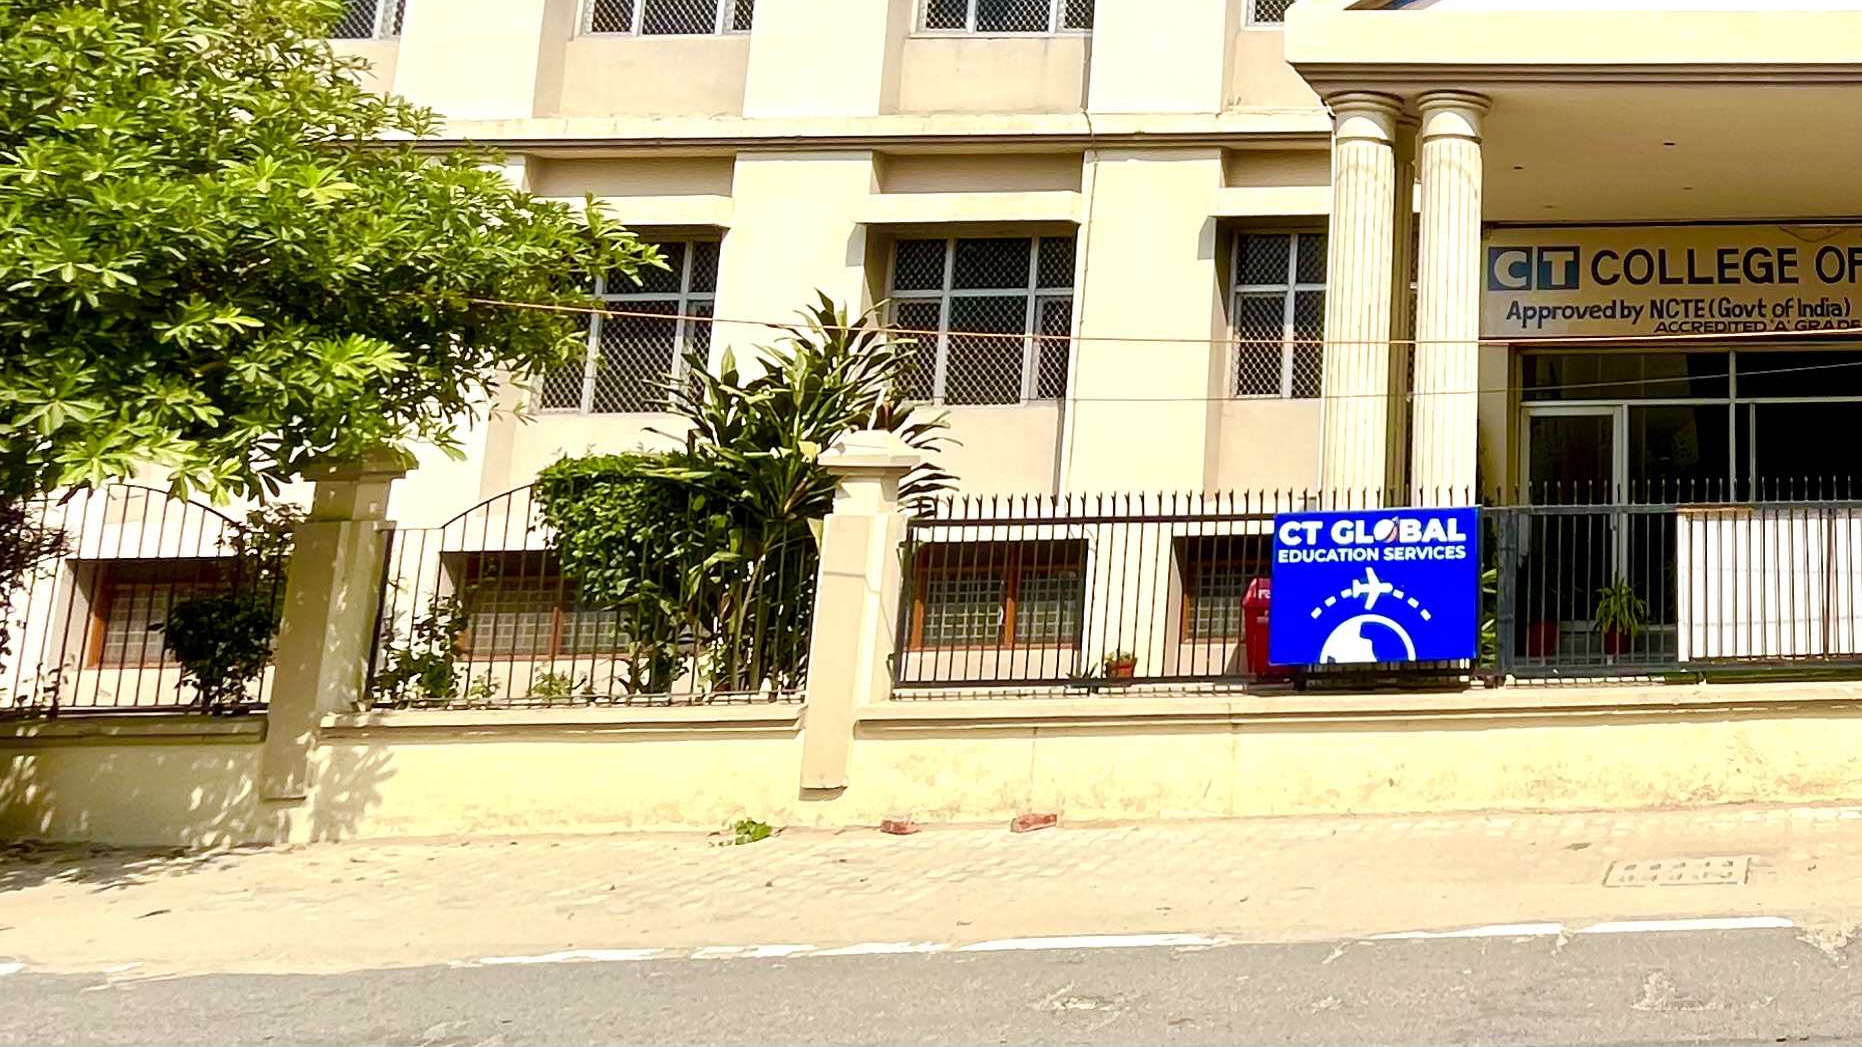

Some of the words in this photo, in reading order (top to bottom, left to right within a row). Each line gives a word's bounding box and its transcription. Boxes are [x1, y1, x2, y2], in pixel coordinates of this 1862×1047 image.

[1492, 248, 1576, 290] CT
[1591, 247, 1799, 285] COLLEGE
[1506, 300, 1616, 329] Approved
[1620, 299, 1646, 325] by
[1772, 297, 1794, 318] of
[1798, 297, 1851, 318] India)
[1653, 320, 1767, 333] ACCREDITED
[1794, 319, 1861, 331] GRADE
[1279, 521, 1323, 546] CT
[1331, 517, 1467, 544] GLOBAL
[1278, 547, 1379, 563] EDUCATION
[1383, 545, 1466, 561] SERVICES
